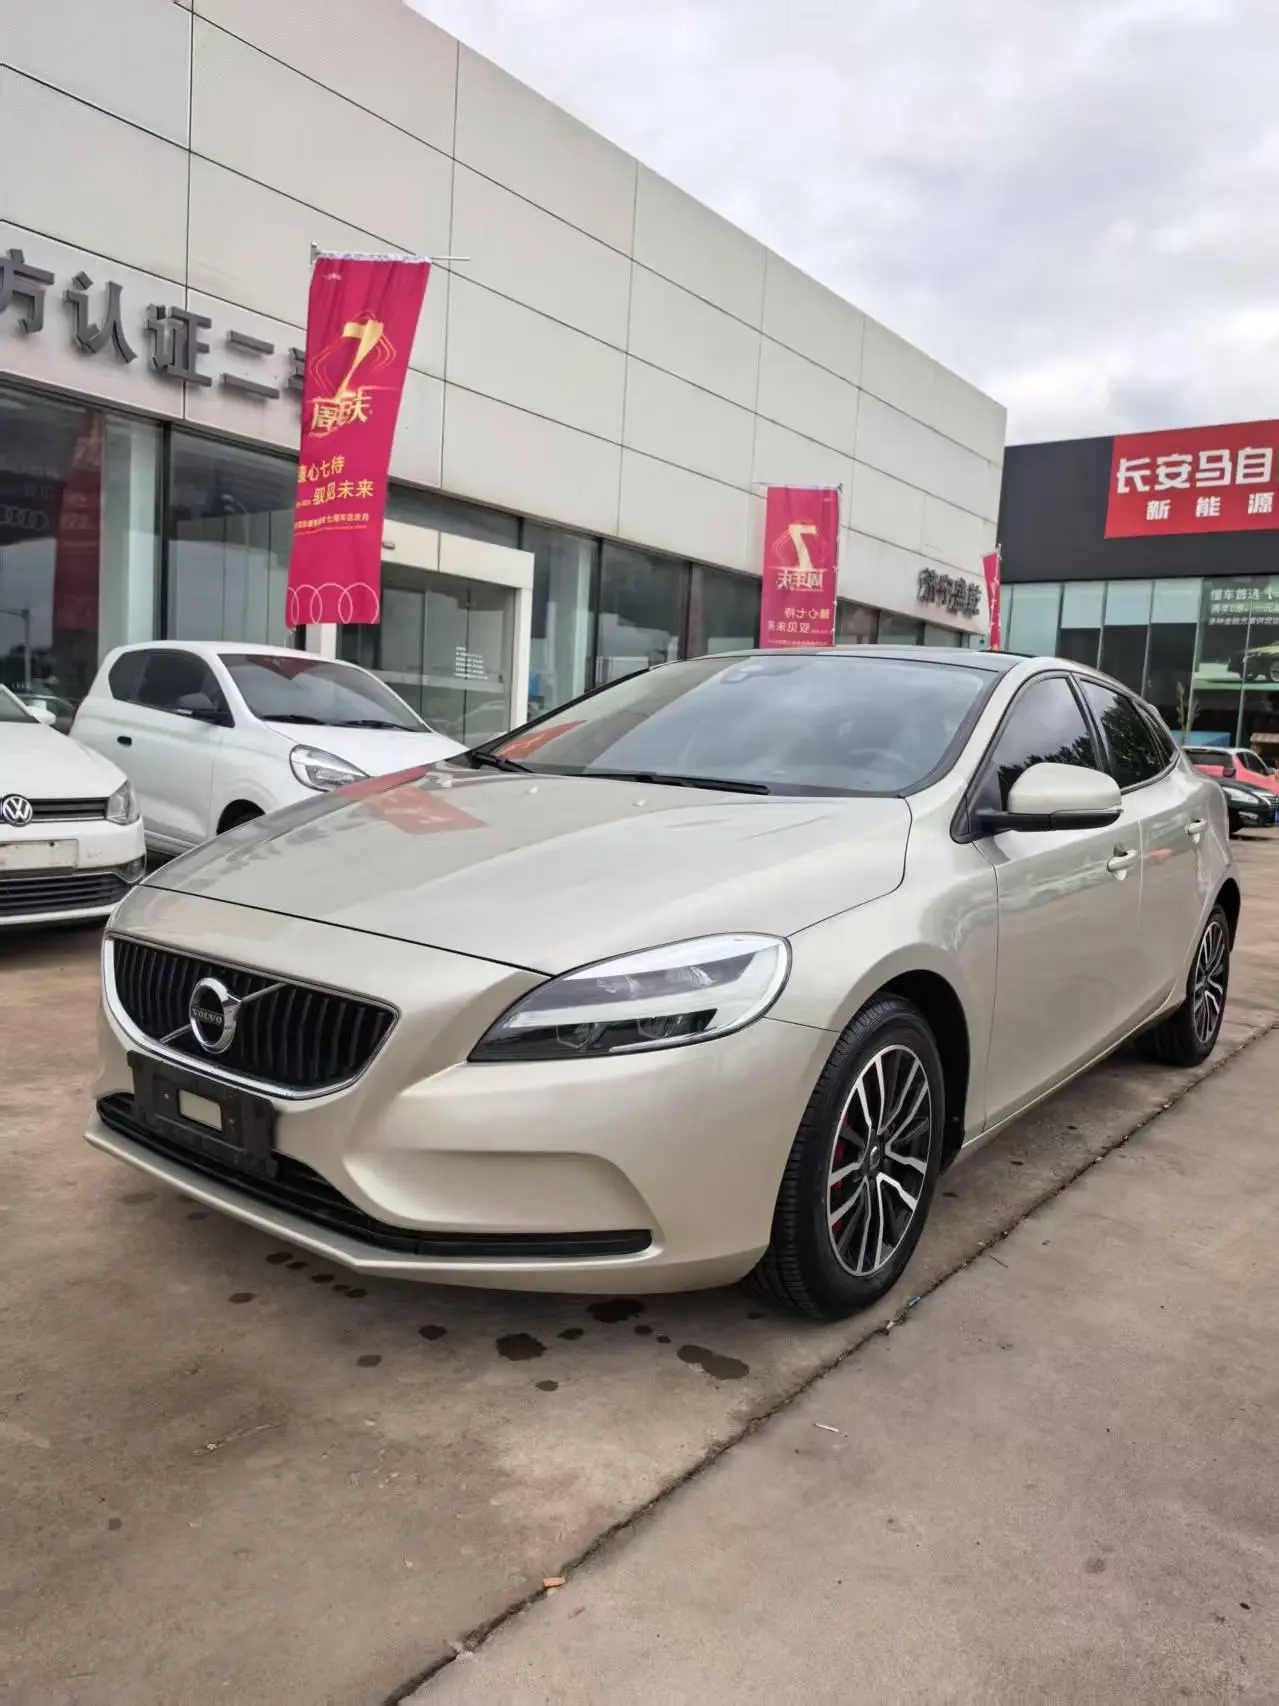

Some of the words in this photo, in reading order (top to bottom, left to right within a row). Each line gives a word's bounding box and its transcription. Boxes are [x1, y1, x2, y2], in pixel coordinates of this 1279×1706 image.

[0, 248, 306, 400] 方认证二
[1117, 447, 1273, 494] 长安马自
[1146, 491, 1274, 520] 新能源
[192, 1008, 223, 1025] VOLVO
